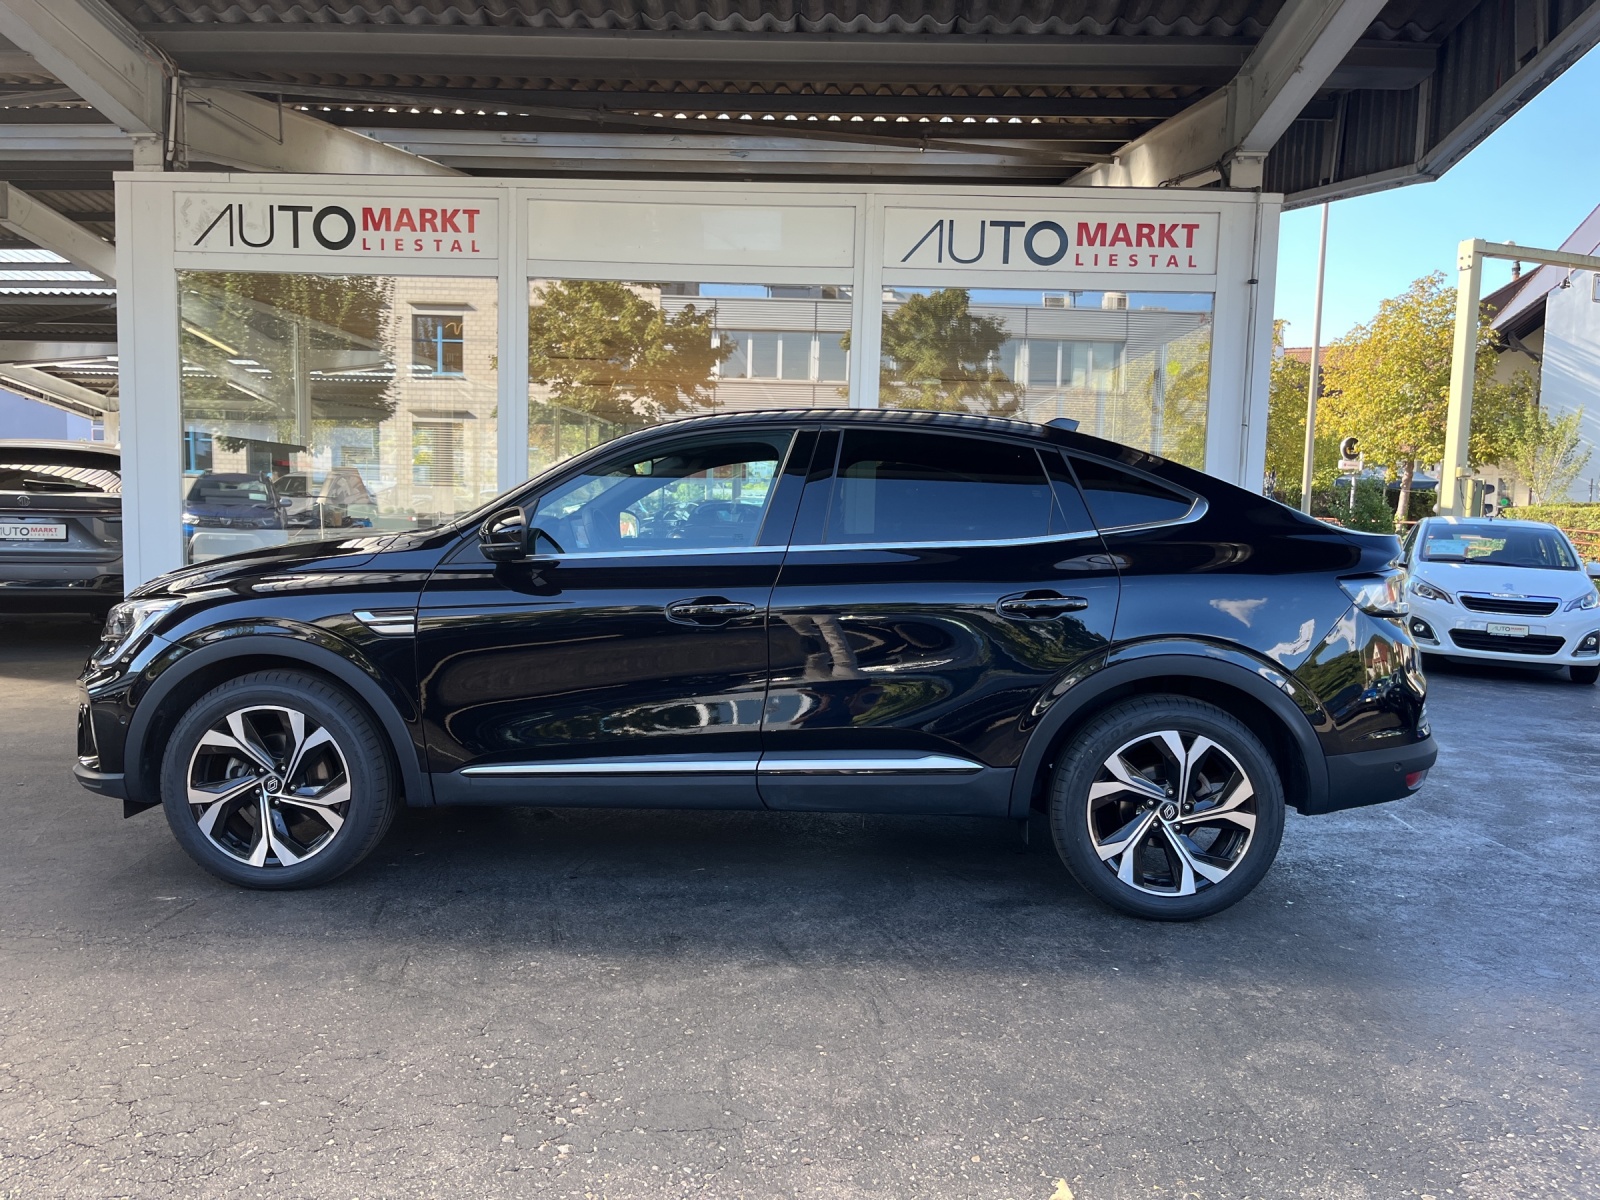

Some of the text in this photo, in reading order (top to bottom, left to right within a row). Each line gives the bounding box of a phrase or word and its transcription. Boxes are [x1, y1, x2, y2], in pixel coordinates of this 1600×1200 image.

[193, 203, 480, 251] AUTO MARKT
[362, 238, 480, 253] LIESTAL
[900, 219, 1200, 267] AUTO MARKT
[1075, 253, 1198, 268] LIESTAL
[0, 527, 30, 536] UTO
